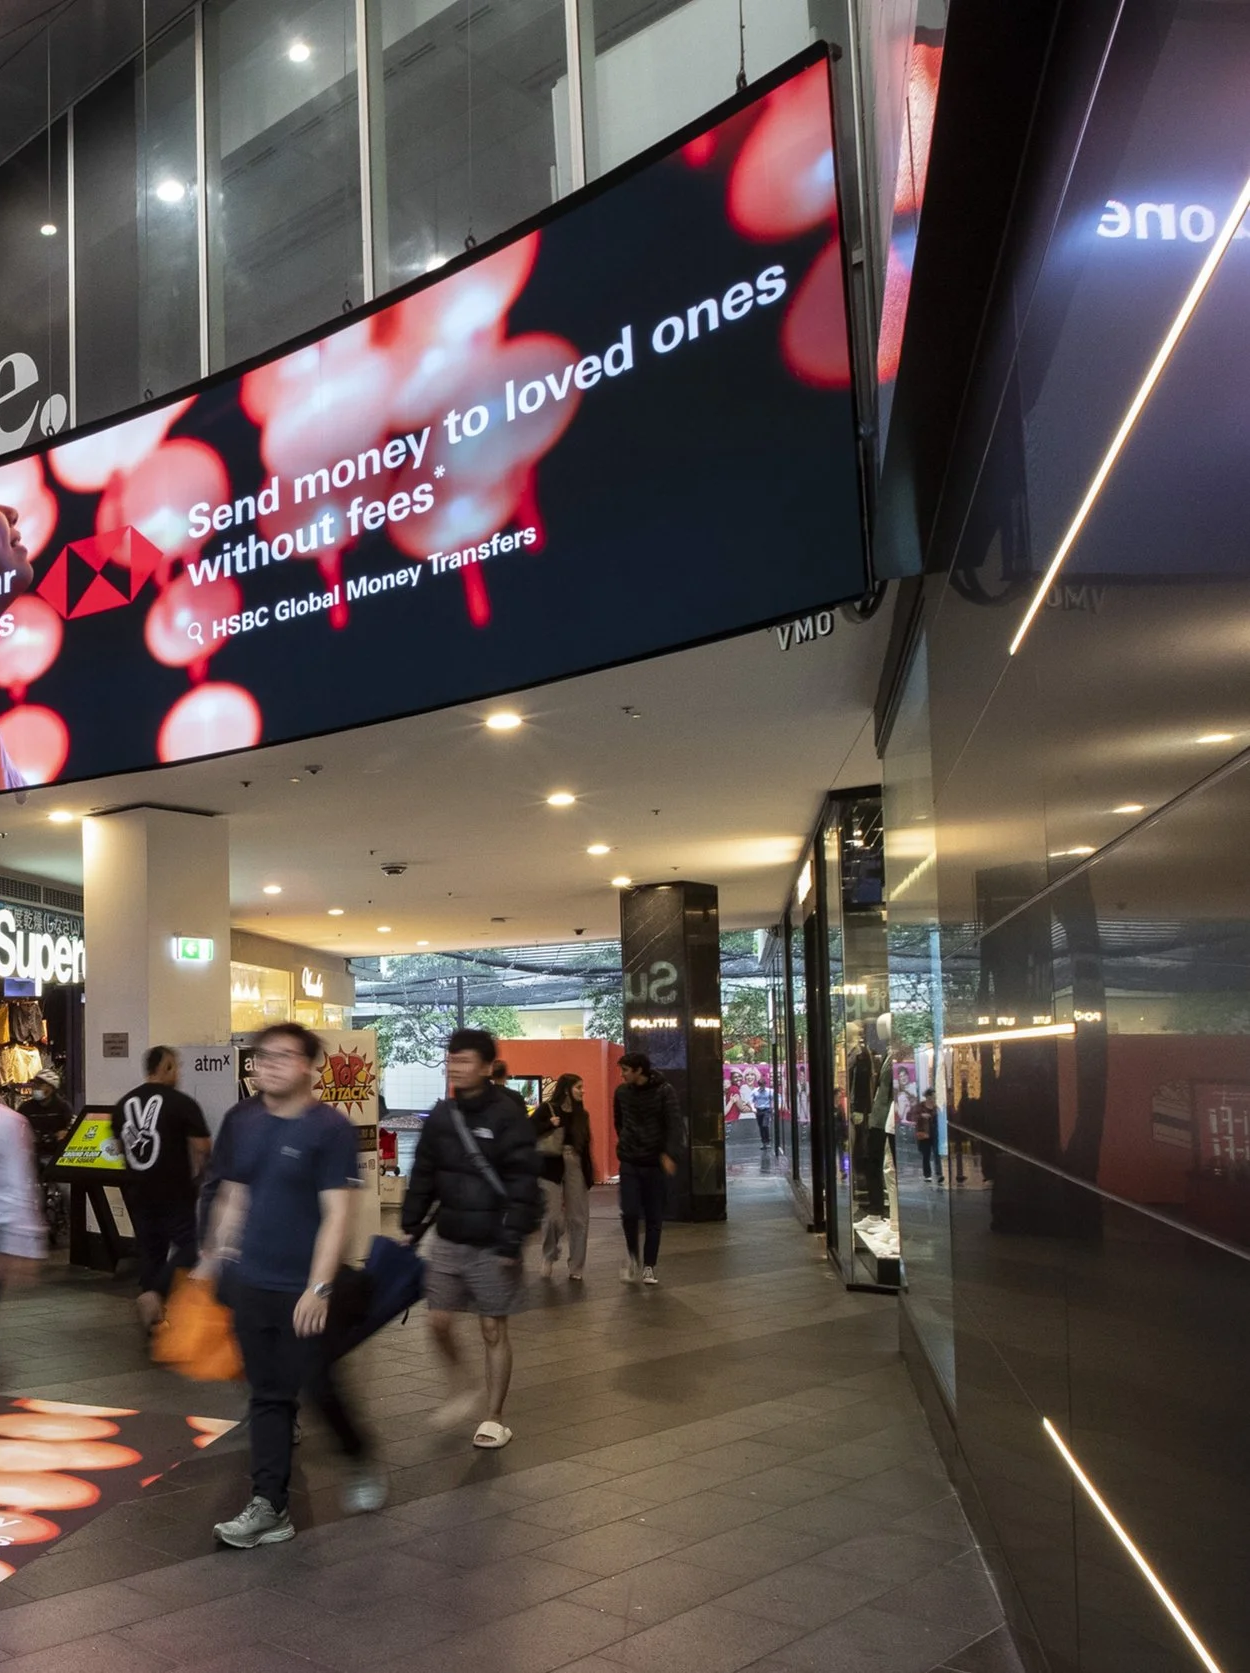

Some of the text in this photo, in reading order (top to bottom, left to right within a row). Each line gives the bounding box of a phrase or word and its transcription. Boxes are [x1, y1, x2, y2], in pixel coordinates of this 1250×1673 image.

[186, 265, 787, 539] Send money to loved ones
[186, 512, 336, 588] without
[211, 526, 537, 640] HSBC Global Money Transfers
[776, 611, 834, 651] VMO
[630, 1018, 678, 1028] POLITIX
[329, 1053, 364, 1087] POP
[321, 1086, 370, 1101] ATTACK
